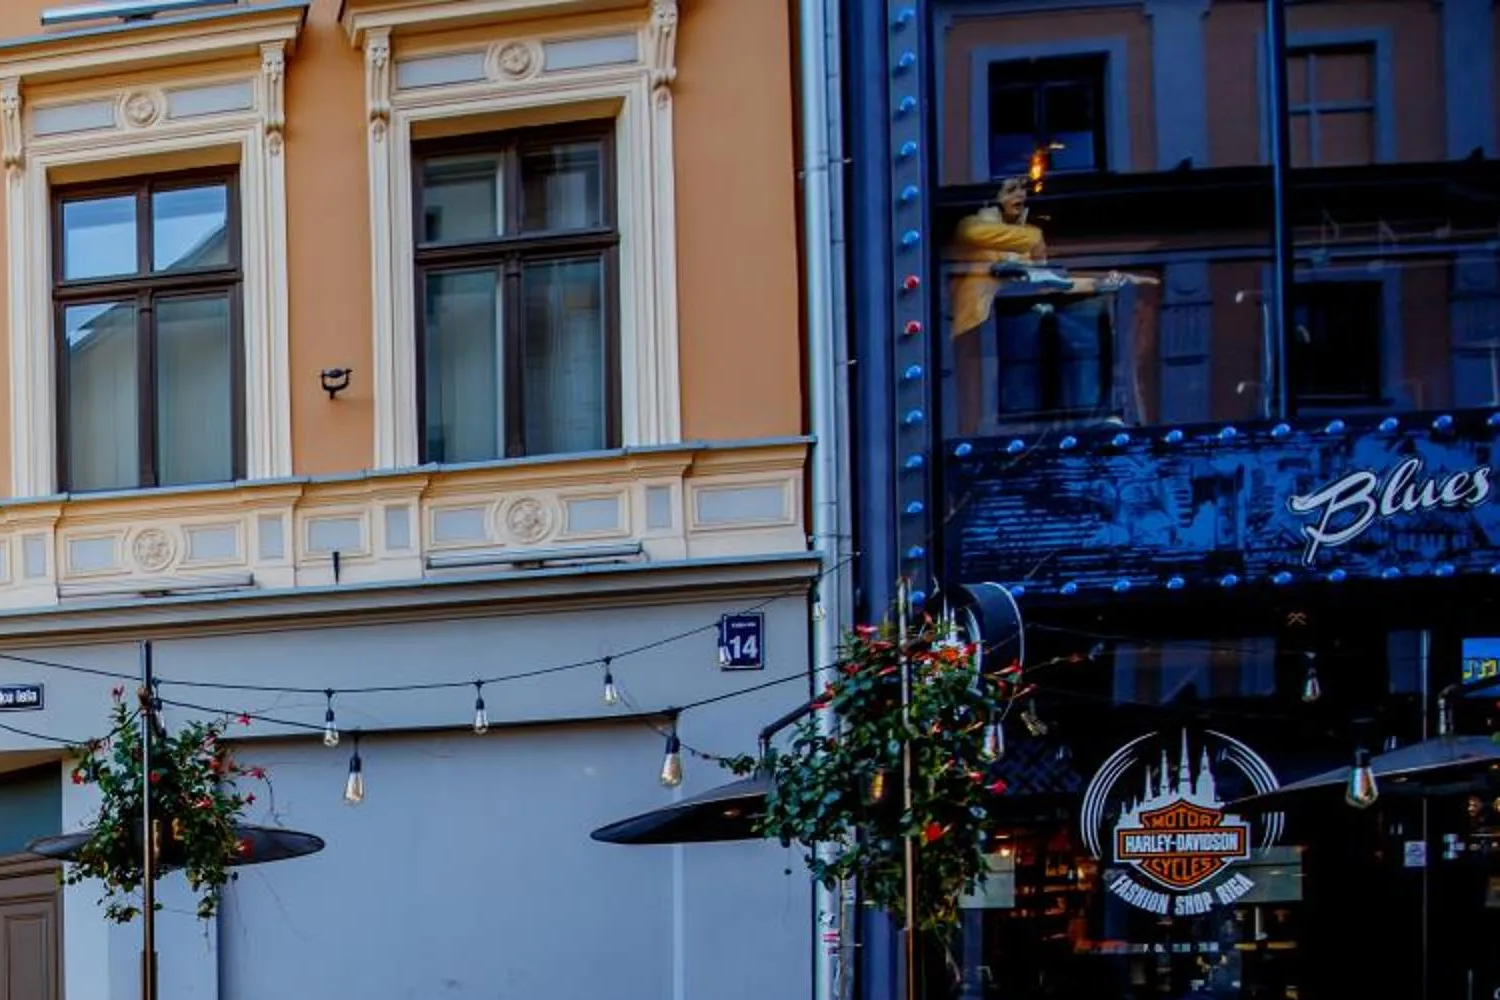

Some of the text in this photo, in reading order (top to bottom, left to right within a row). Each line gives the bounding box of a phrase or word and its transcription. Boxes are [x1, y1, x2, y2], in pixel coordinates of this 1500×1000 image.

[1292, 458, 1491, 563] Blues
[730, 635, 758, 658] 14
[1152, 807, 1211, 827] MOTOR
[1125, 832, 1238, 853] HARLEY-DAVIDSON
[1152, 858, 1212, 881] CYCLES
[1109, 873, 1255, 915] FASHION SHOP RIGA
